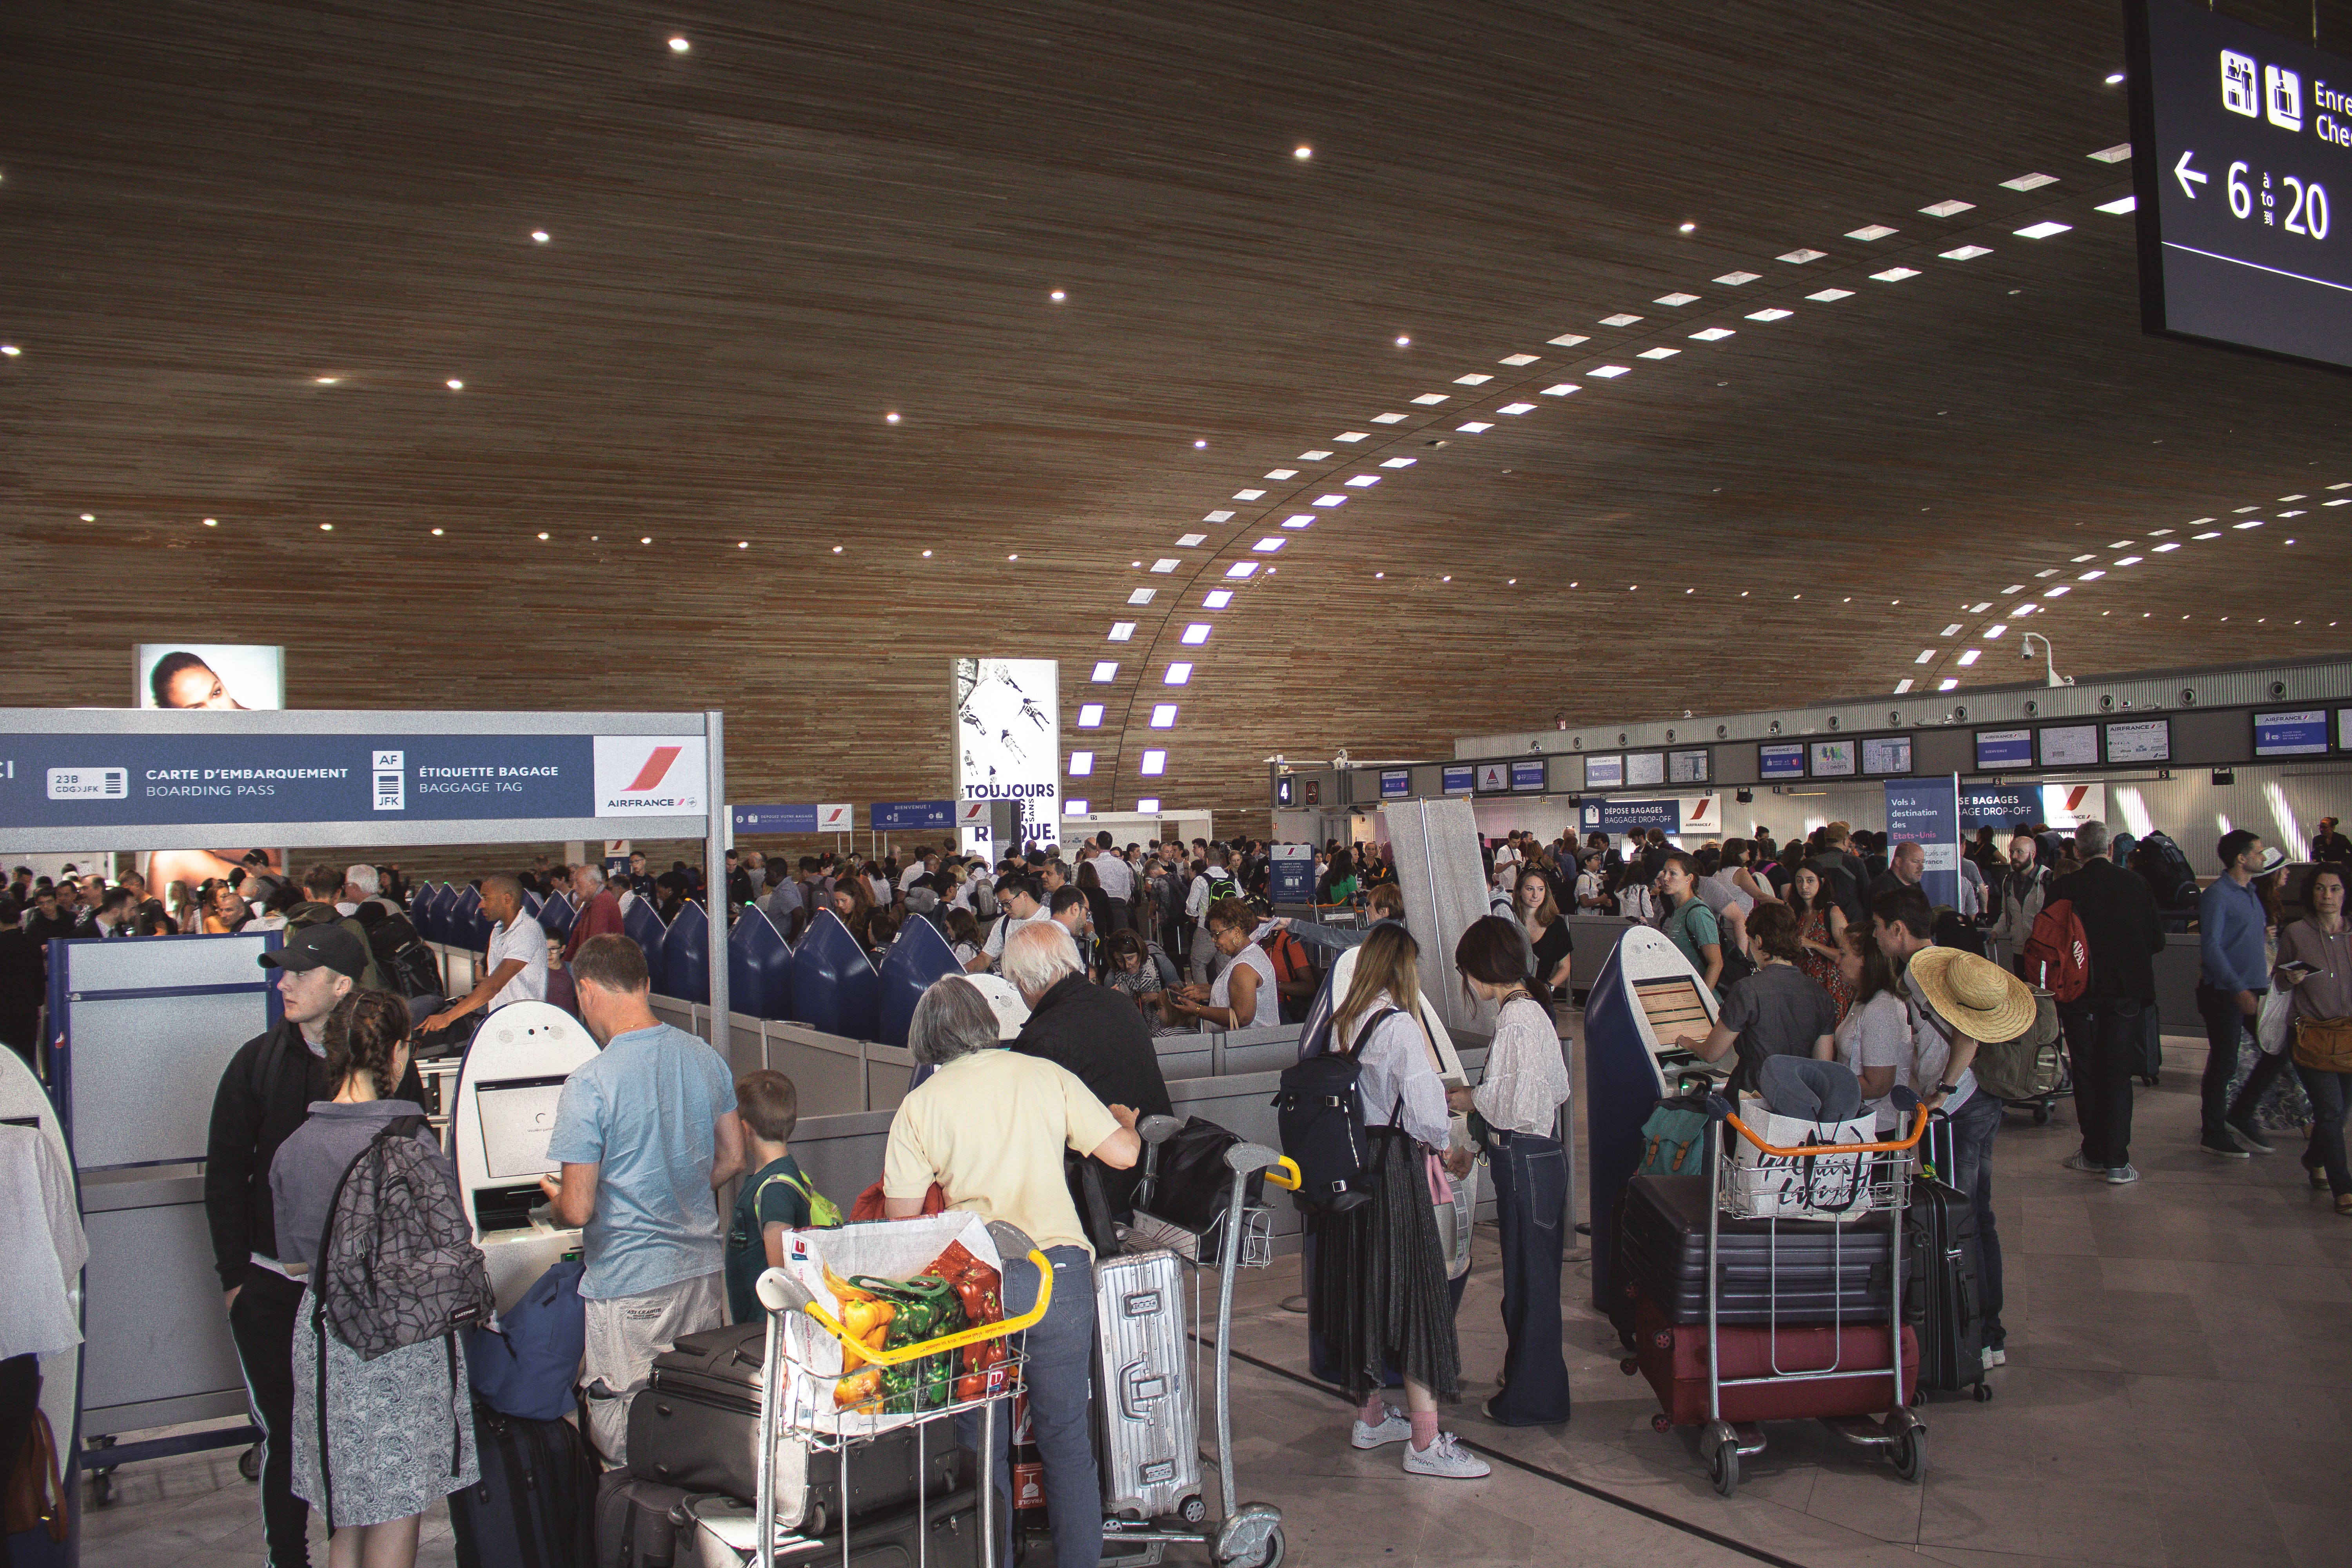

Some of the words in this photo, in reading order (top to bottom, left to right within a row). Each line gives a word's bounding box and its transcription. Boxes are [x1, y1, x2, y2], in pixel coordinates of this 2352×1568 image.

[2228, 162, 2251, 219] 6
[2263, 172, 2270, 189] à
[2283, 176, 2328, 240] 20
[2260, 191, 2273, 207] to
[379, 755, 397, 765] AF
[146, 769, 199, 780] CARTE
[204, 768, 349, 780] D'EMBARQUEMENT
[419, 766, 494, 778] ÉTIQUETTE
[499, 767, 559, 777] BAGAGE
[56, 775, 78, 784] 23B
[147, 785, 232, 797] BOARDING
[238, 785, 275, 796] PASS
[419, 782, 490, 793] BAGGAGE
[495, 782, 523, 792] TAG
[965, 783, 1054, 799] TOUJOURS
[1280, 783, 1288, 800] 4
[379, 797, 399, 806] JFK
[608, 799, 675, 807] AIRFRANCE
[1973, 795, 2019, 804] BAGAGES
[1604, 807, 1629, 815] DÉPOSE
[1891, 809, 1938, 817] destination
[1983, 806, 2032, 815] DROP-OFF
[1893, 831, 1936, 840] Etats-Unis
